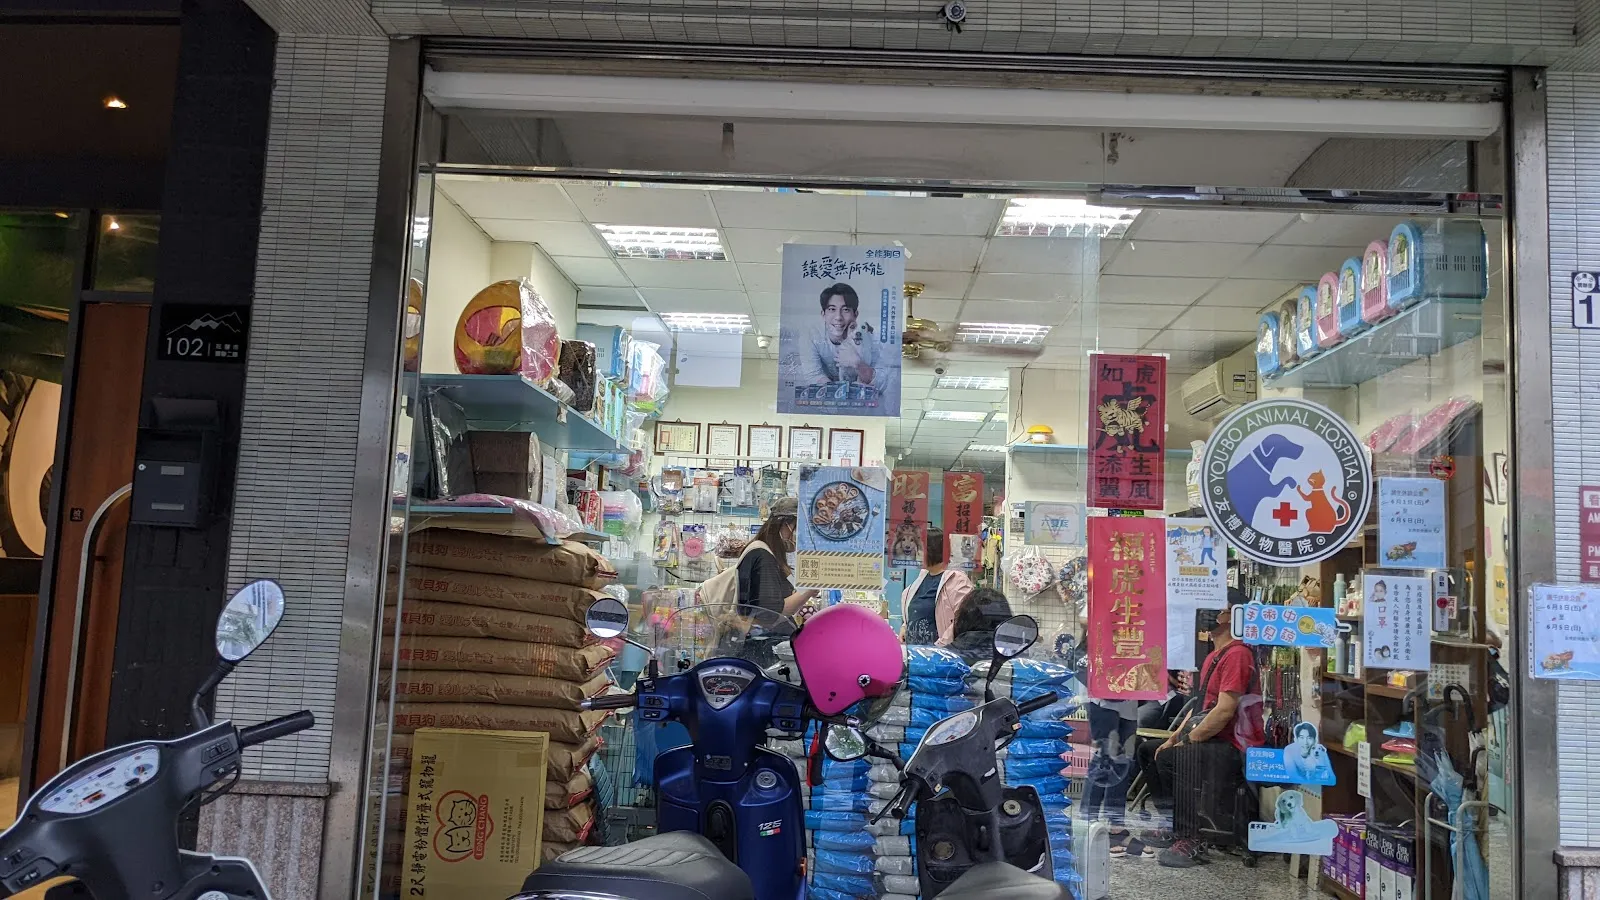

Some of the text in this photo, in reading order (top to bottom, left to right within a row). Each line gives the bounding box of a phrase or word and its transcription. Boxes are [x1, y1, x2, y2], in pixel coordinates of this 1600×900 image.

[801, 255, 885, 280] 讓愛無所不能
[166, 337, 204, 356] 102
[1210, 408, 1361, 487] YOU-BO ANIMAL HOSPITAL
[892, 473, 926, 499] 旺
[952, 474, 978, 503] 富
[1215, 497, 1314, 556] 友博動物醫院
[1246, 605, 1297, 622] 手術中
[758, 819, 782, 830] 125
